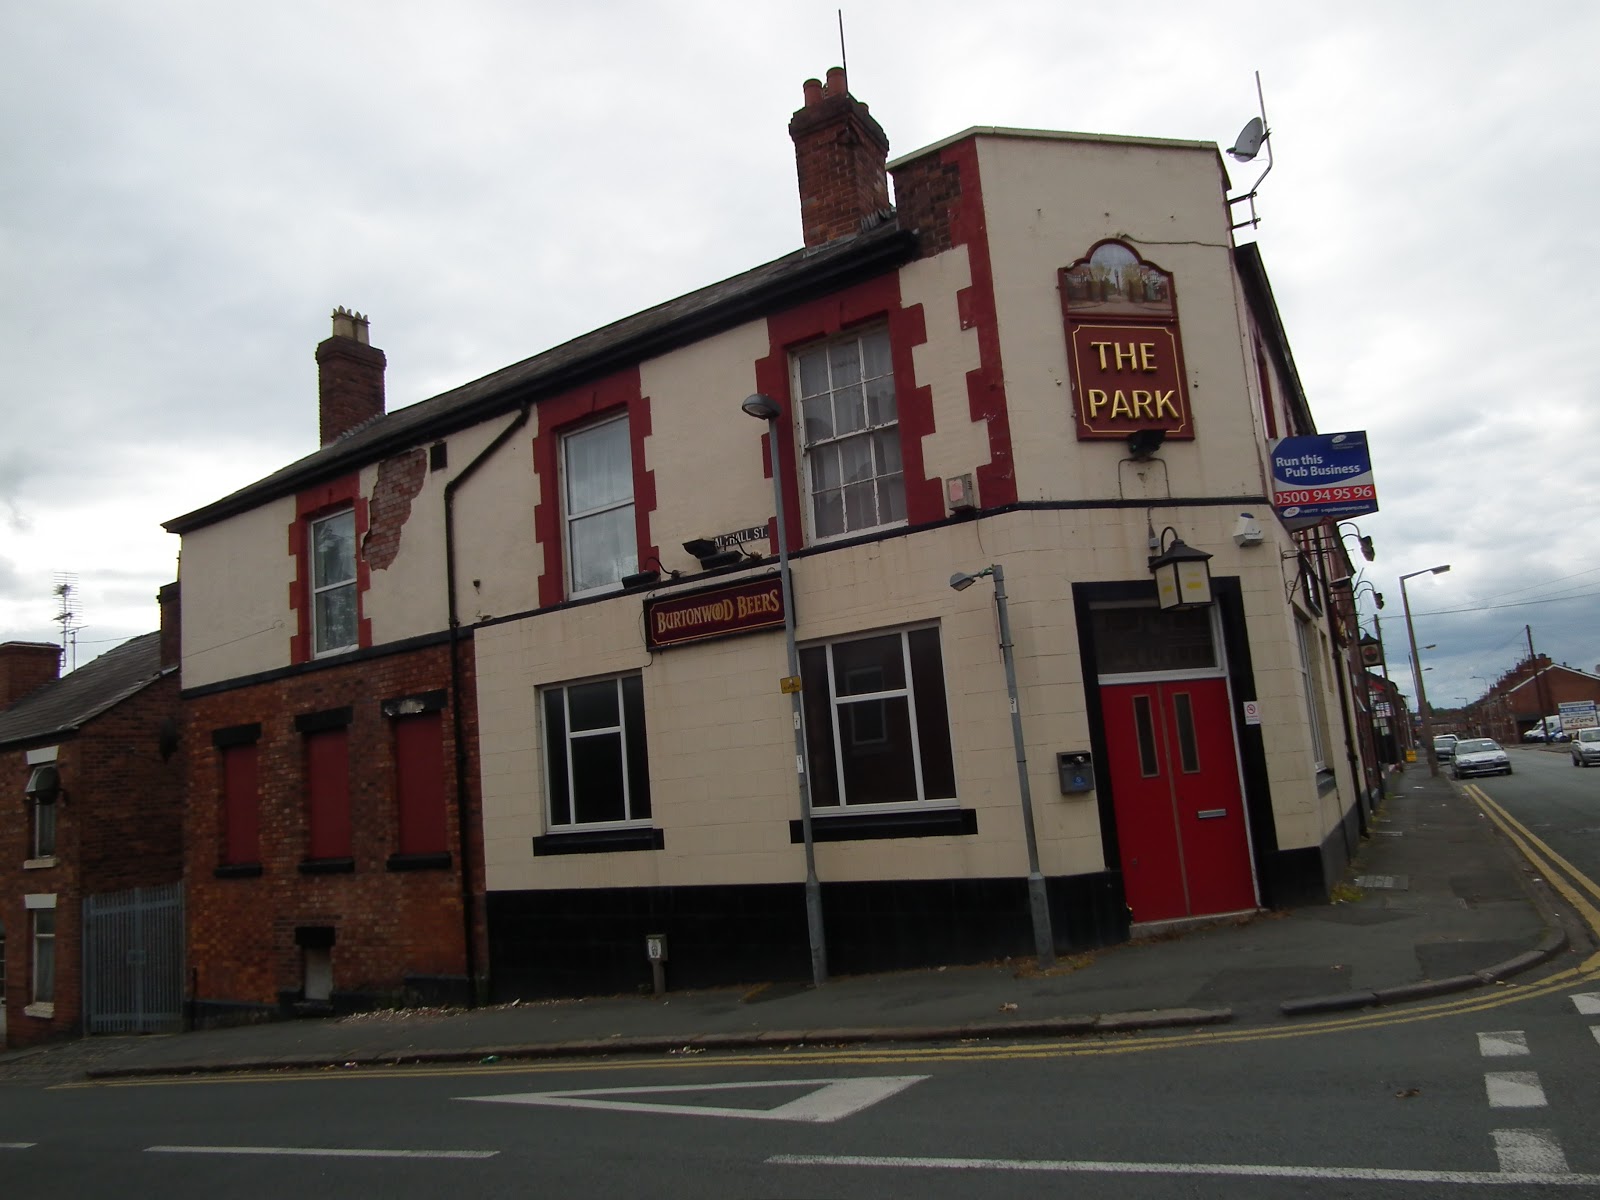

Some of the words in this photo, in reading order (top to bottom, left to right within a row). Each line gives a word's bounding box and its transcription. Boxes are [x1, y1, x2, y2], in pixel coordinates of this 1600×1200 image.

[1090, 341, 1158, 371] THE
[1088, 389, 1180, 419] PARK
[1275, 457, 1299, 467] Run
[1301, 454, 1324, 465] this
[1285, 466, 1308, 478] Pub
[1310, 464, 1361, 476] Business
[1313, 489, 1331, 502] 94
[1333, 487, 1351, 500] 95
[1353, 485, 1373, 498] 96
[656, 599, 734, 634] BURTONWOOD
[736, 588, 780, 619] BEERS
